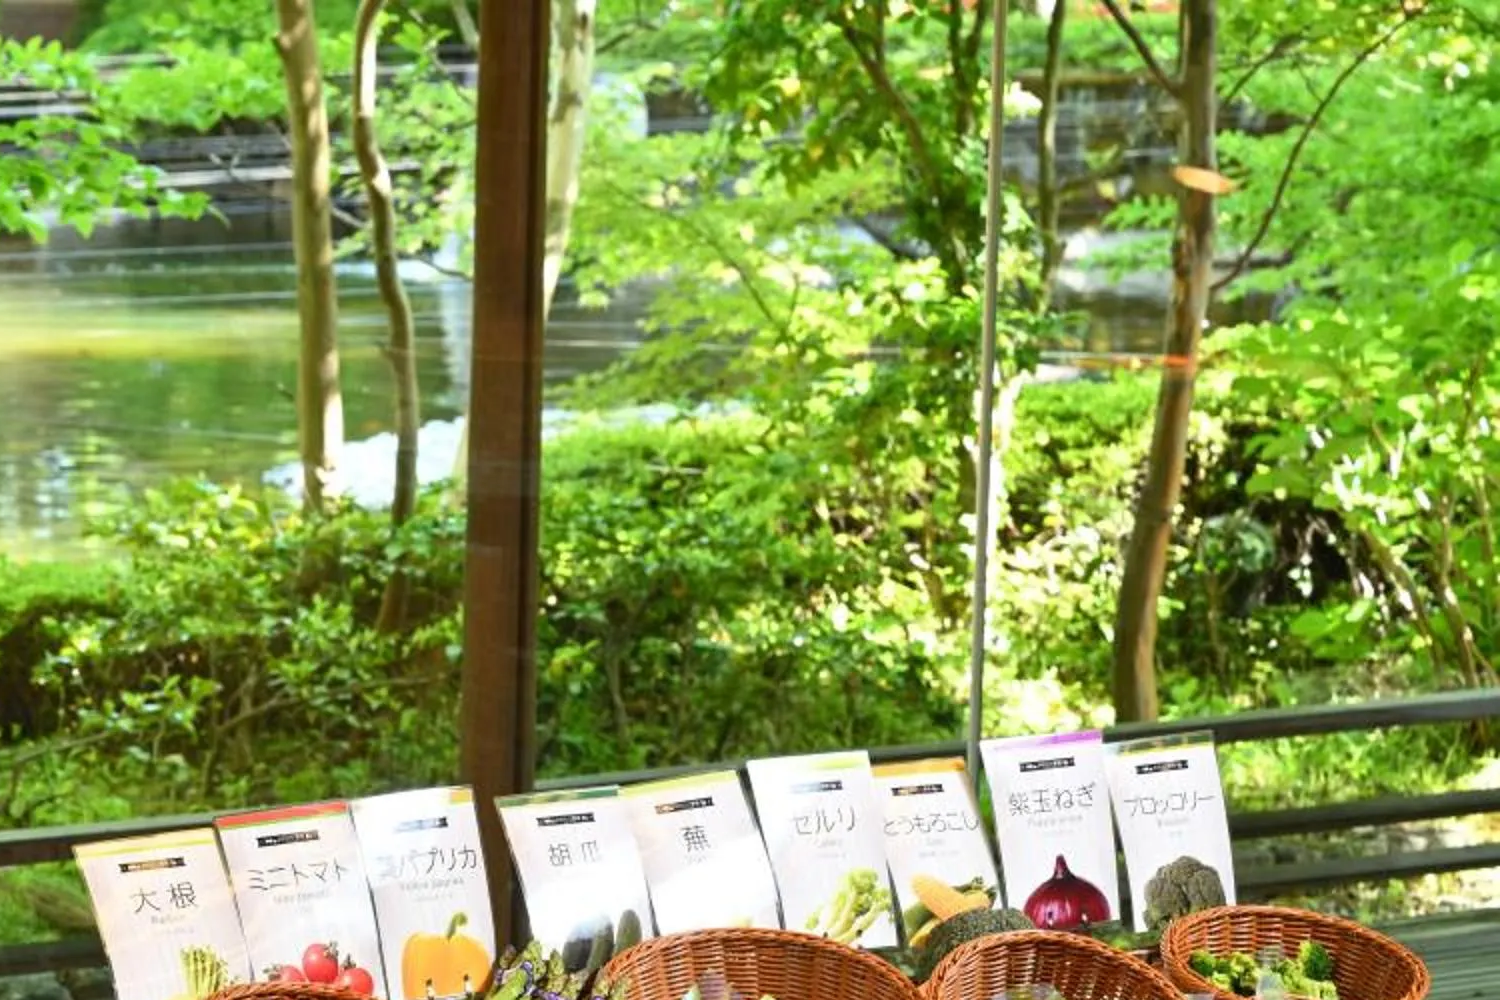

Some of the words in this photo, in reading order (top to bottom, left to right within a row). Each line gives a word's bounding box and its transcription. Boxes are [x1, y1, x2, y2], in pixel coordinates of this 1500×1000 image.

[883, 810, 980, 837] とうもろこし
[247, 857, 348, 891] ミニトマト
[130, 880, 203, 914] 大根
